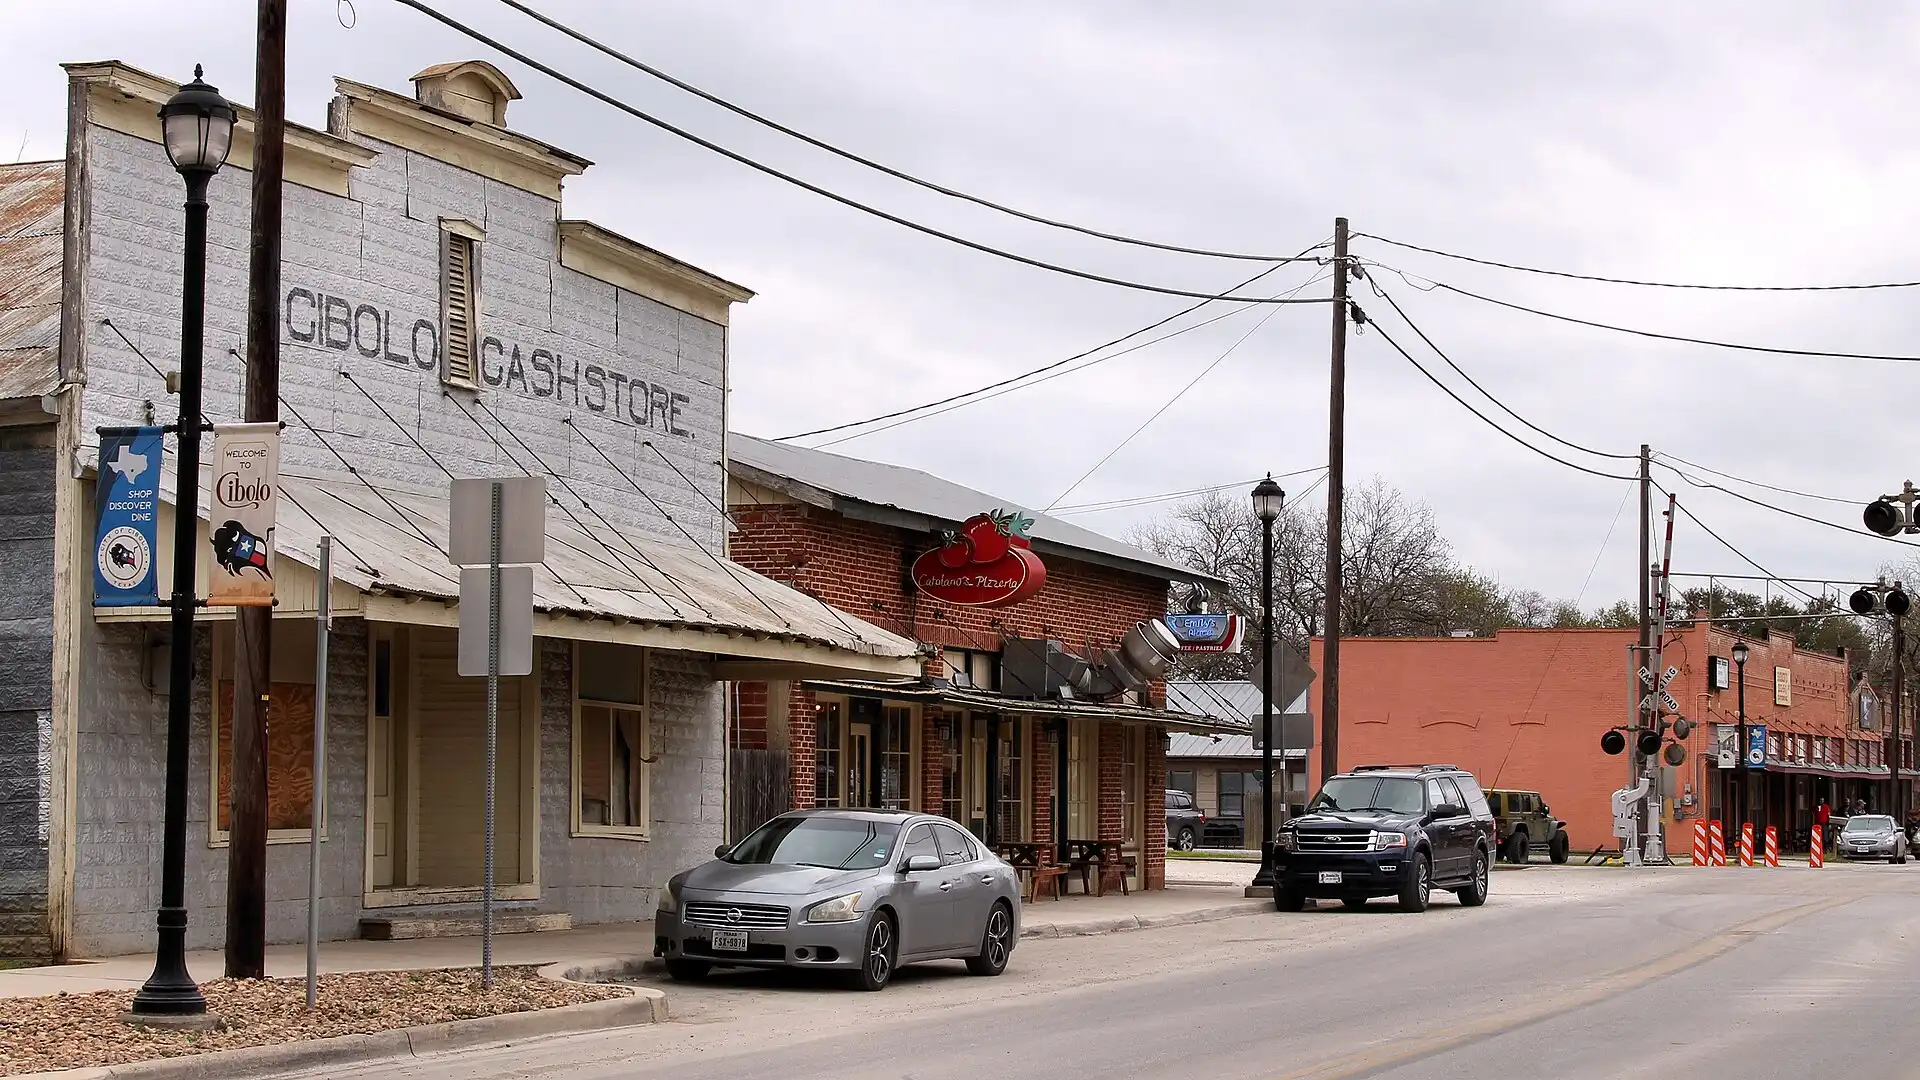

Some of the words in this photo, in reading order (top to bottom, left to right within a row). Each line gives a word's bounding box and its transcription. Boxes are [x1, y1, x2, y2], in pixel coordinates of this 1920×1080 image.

[286, 286, 438, 371] CIBOLO
[481, 336, 580, 406] CASH
[226, 449, 267, 458] WELCOME
[239, 461, 252, 469] TO
[128, 489, 153, 499] SHOP
[216, 471, 271, 510] Cibolo
[109, 501, 152, 510] DISCOVER
[131, 512, 152, 522] DINE
[100, 533, 112, 552] CITY
[114, 527, 125, 535] OF
[127, 528, 149, 552] CIBOLO
[113, 580, 137, 588] TEXAS
[975, 575, 1018, 589] Pizzeria
[1184, 618, 1216, 628] Emily's
[1638, 668, 1678, 710] RAROAD
